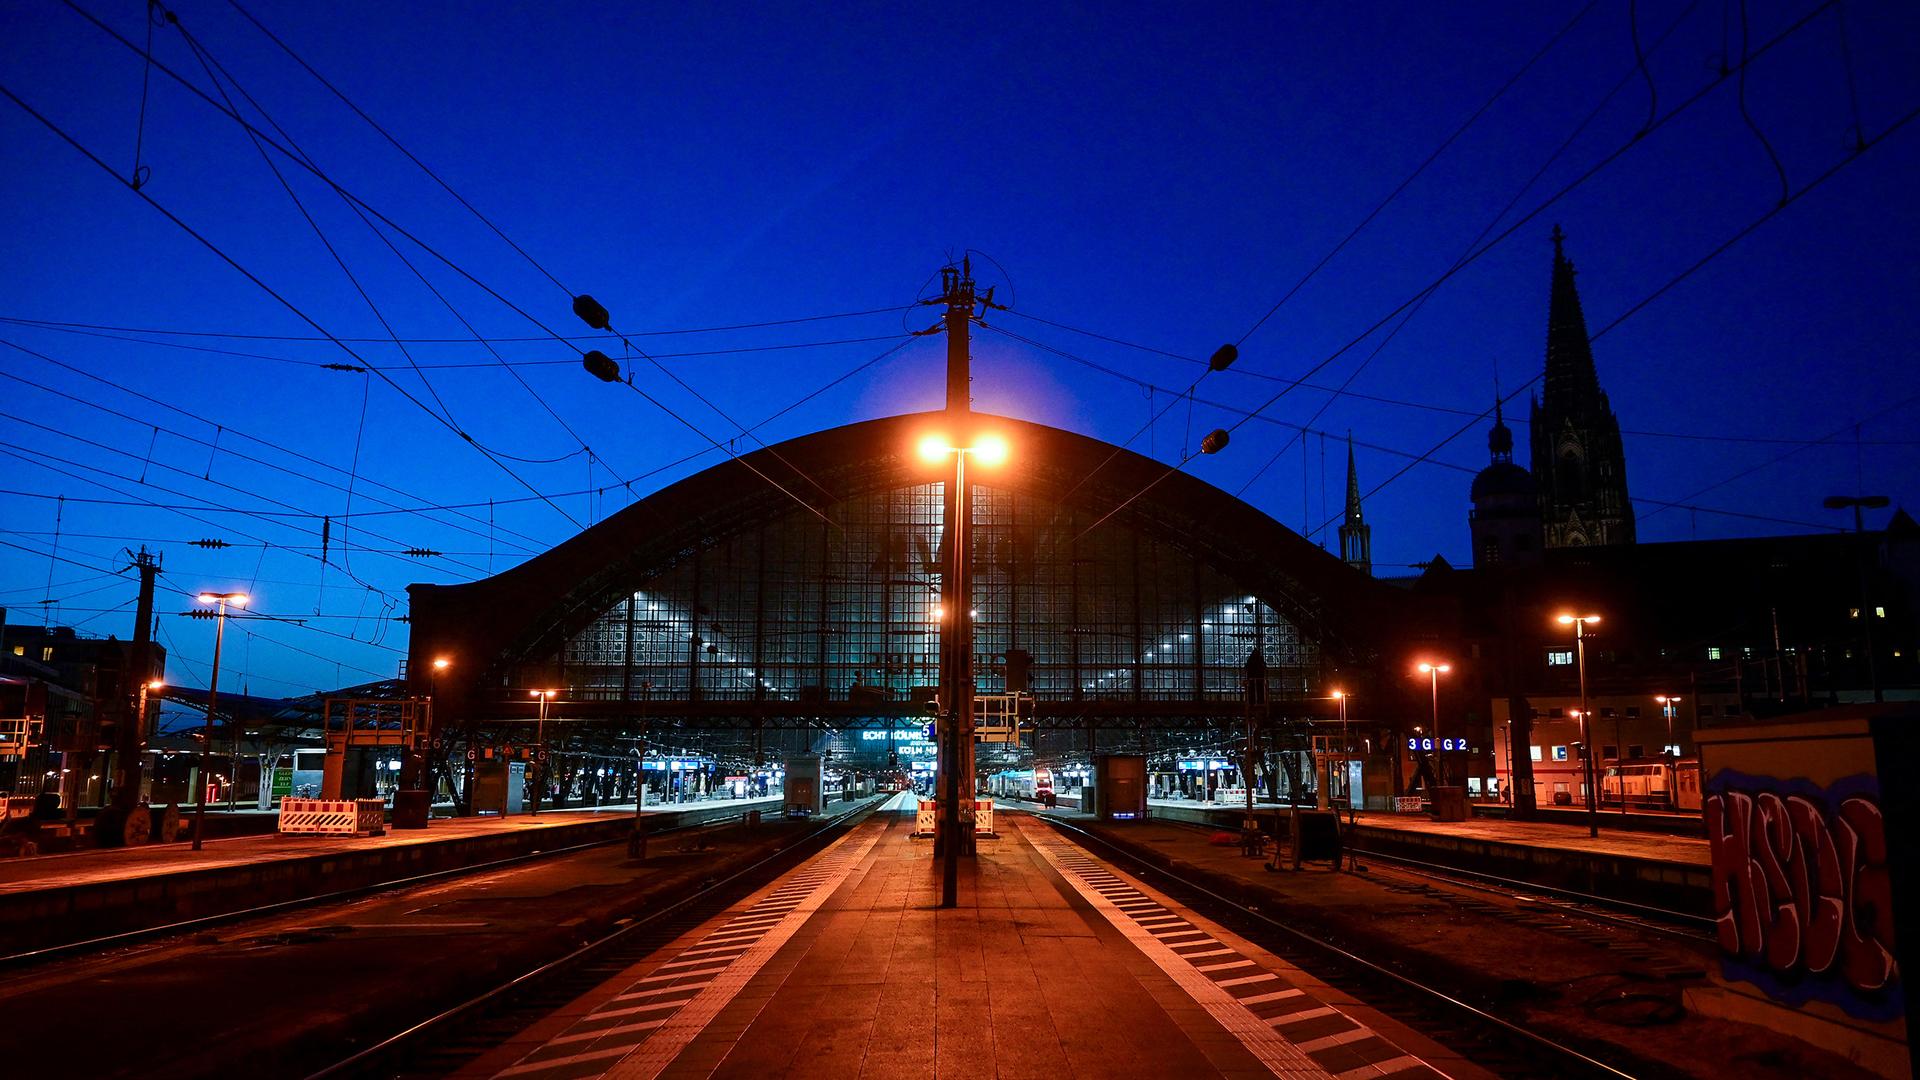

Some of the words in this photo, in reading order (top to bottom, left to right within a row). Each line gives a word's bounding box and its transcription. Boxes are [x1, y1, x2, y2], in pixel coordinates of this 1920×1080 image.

[862, 731, 887, 740] ECHT
[922, 725, 930, 736] 5
[1408, 738, 1417, 750] 3
[1422, 738, 1432, 751] G
[1443, 738, 1453, 751] G
[1458, 738, 1467, 750] 2
[467, 748, 476, 760] G
